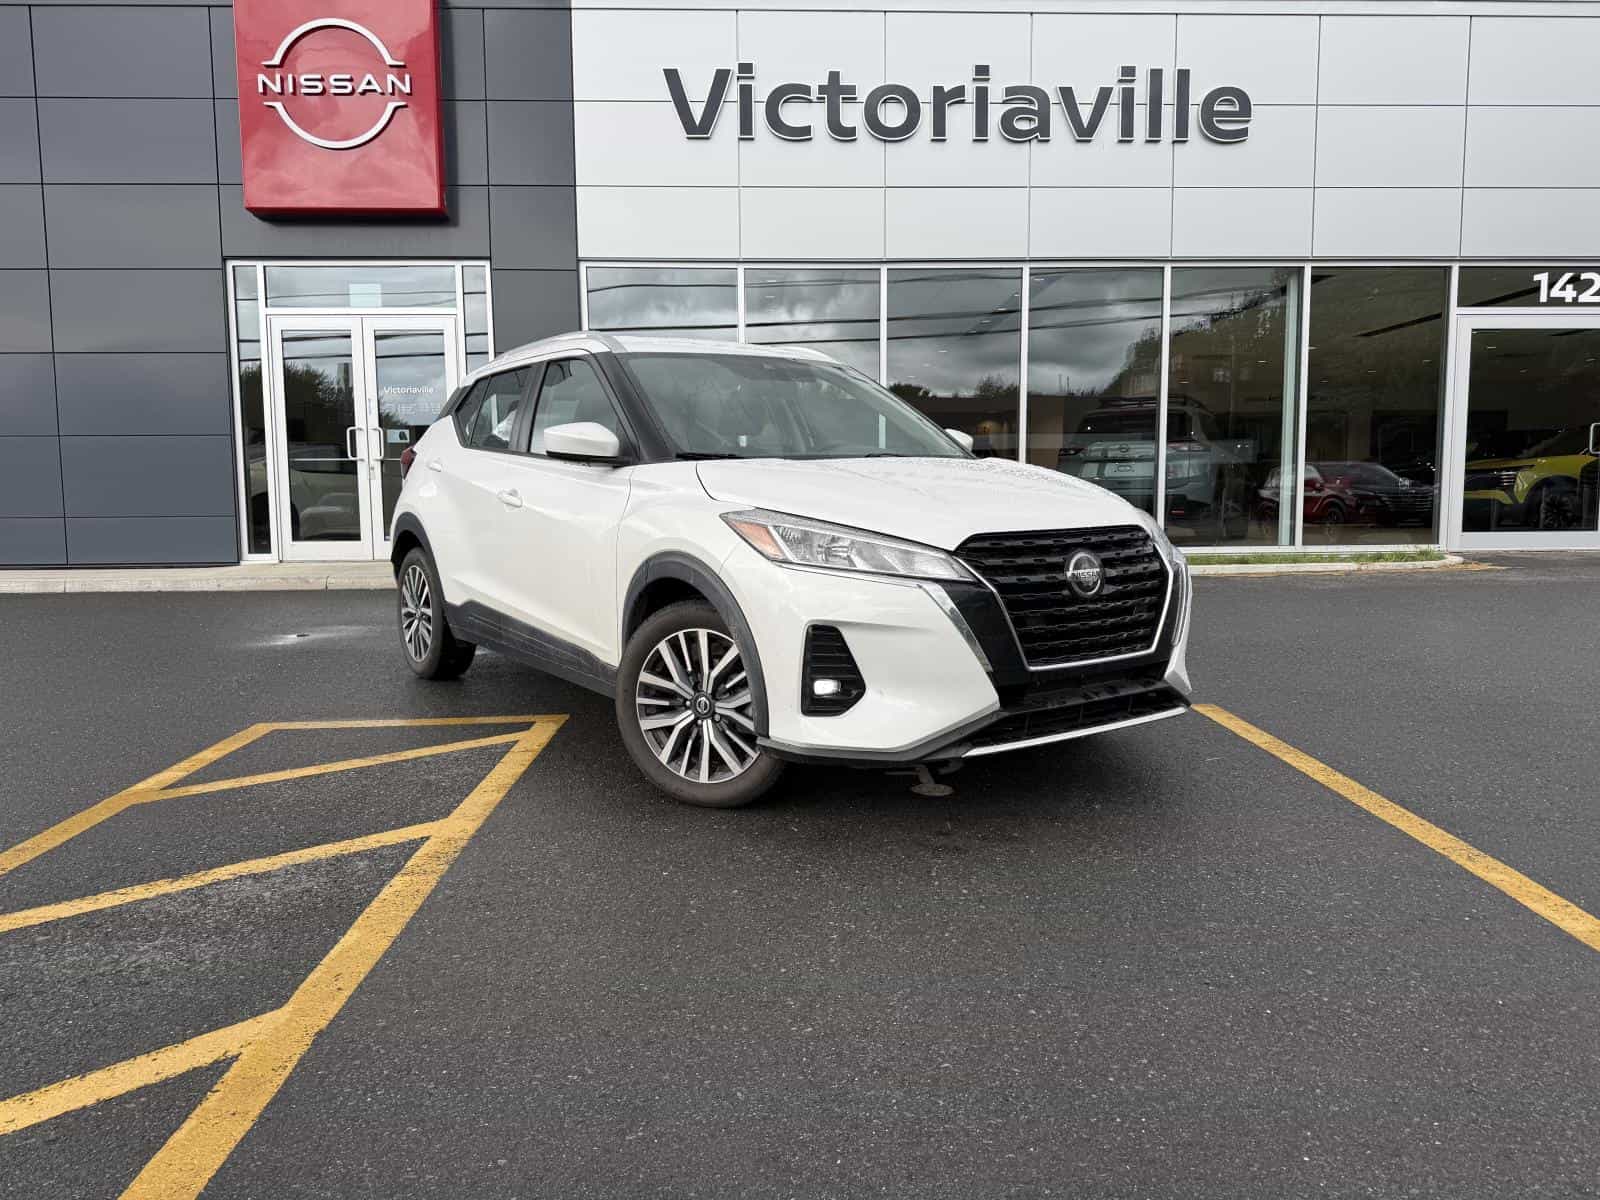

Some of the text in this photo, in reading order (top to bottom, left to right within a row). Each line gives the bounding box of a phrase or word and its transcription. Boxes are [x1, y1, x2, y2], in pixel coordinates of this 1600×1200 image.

[257, 73, 412, 95] NISSAN
[662, 61, 1253, 144] Victoriaville
[383, 384, 434, 394] Victoriaville
